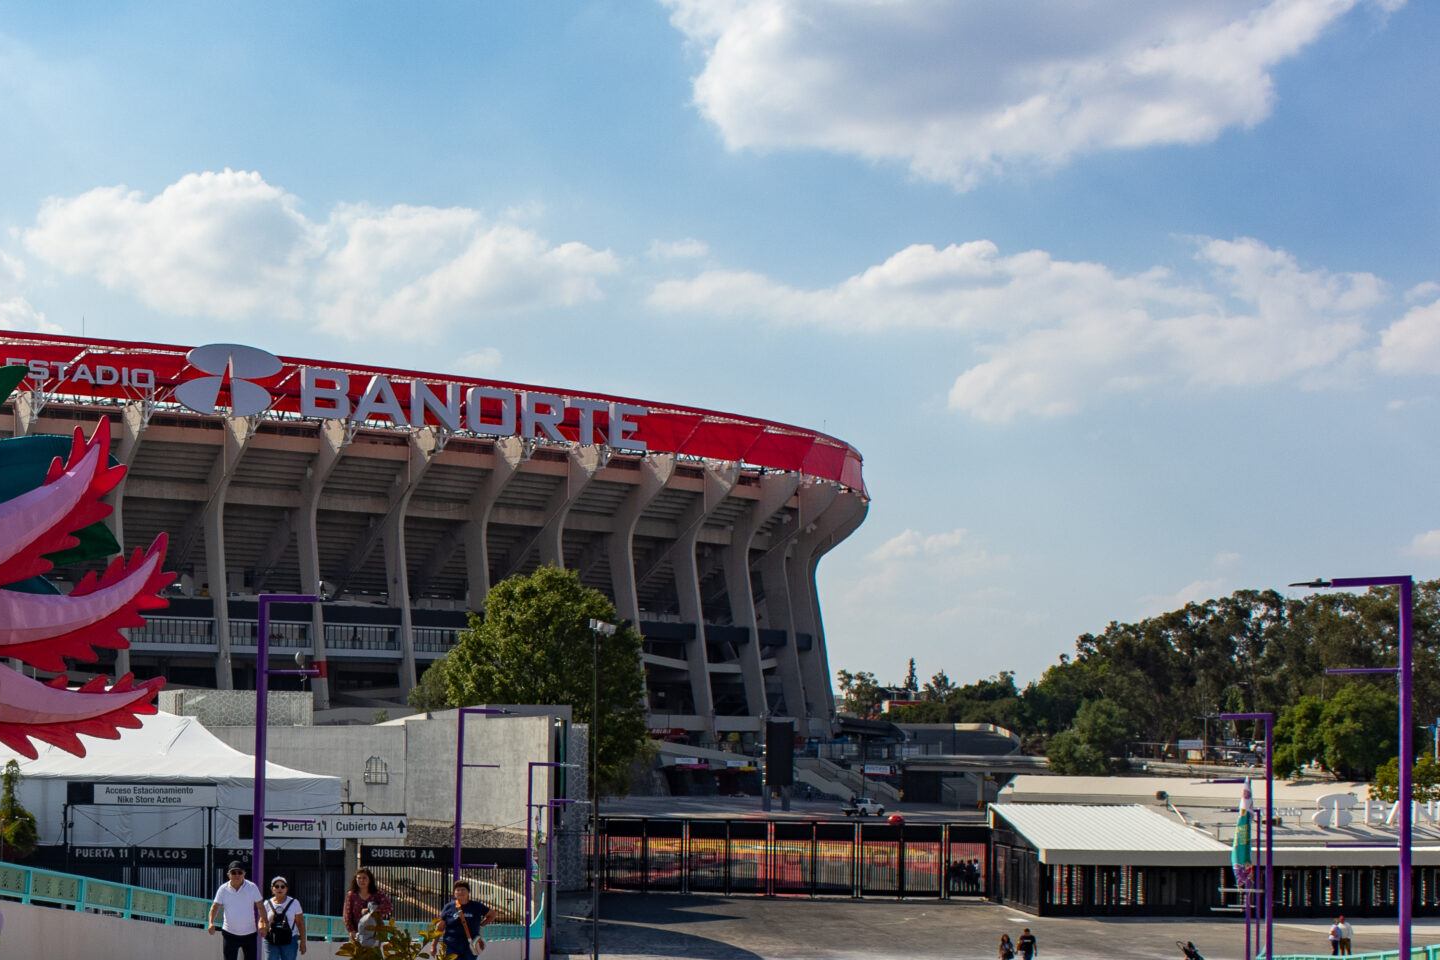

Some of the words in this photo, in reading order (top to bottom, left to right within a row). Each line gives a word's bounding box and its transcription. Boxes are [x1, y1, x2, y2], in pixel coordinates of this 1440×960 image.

[300, 366, 648, 450] BANORTE
[105, 786, 132, 794] Acceso
[133, 786, 194, 794] Estacionamiento
[117, 795, 134, 804] Nike
[135, 795, 155, 804] Store
[156, 795, 182, 804] Azteca
[281, 820, 314, 832] Puerta
[335, 820, 378, 832] Cubierto
[379, 821, 395, 832] AA
[75, 848, 115, 858] PUERTA
[119, 848, 129, 858] 11
[140, 849, 188, 860] PALCOS
[371, 847, 417, 859] CUBIERTO
[420, 848, 436, 860] AA
